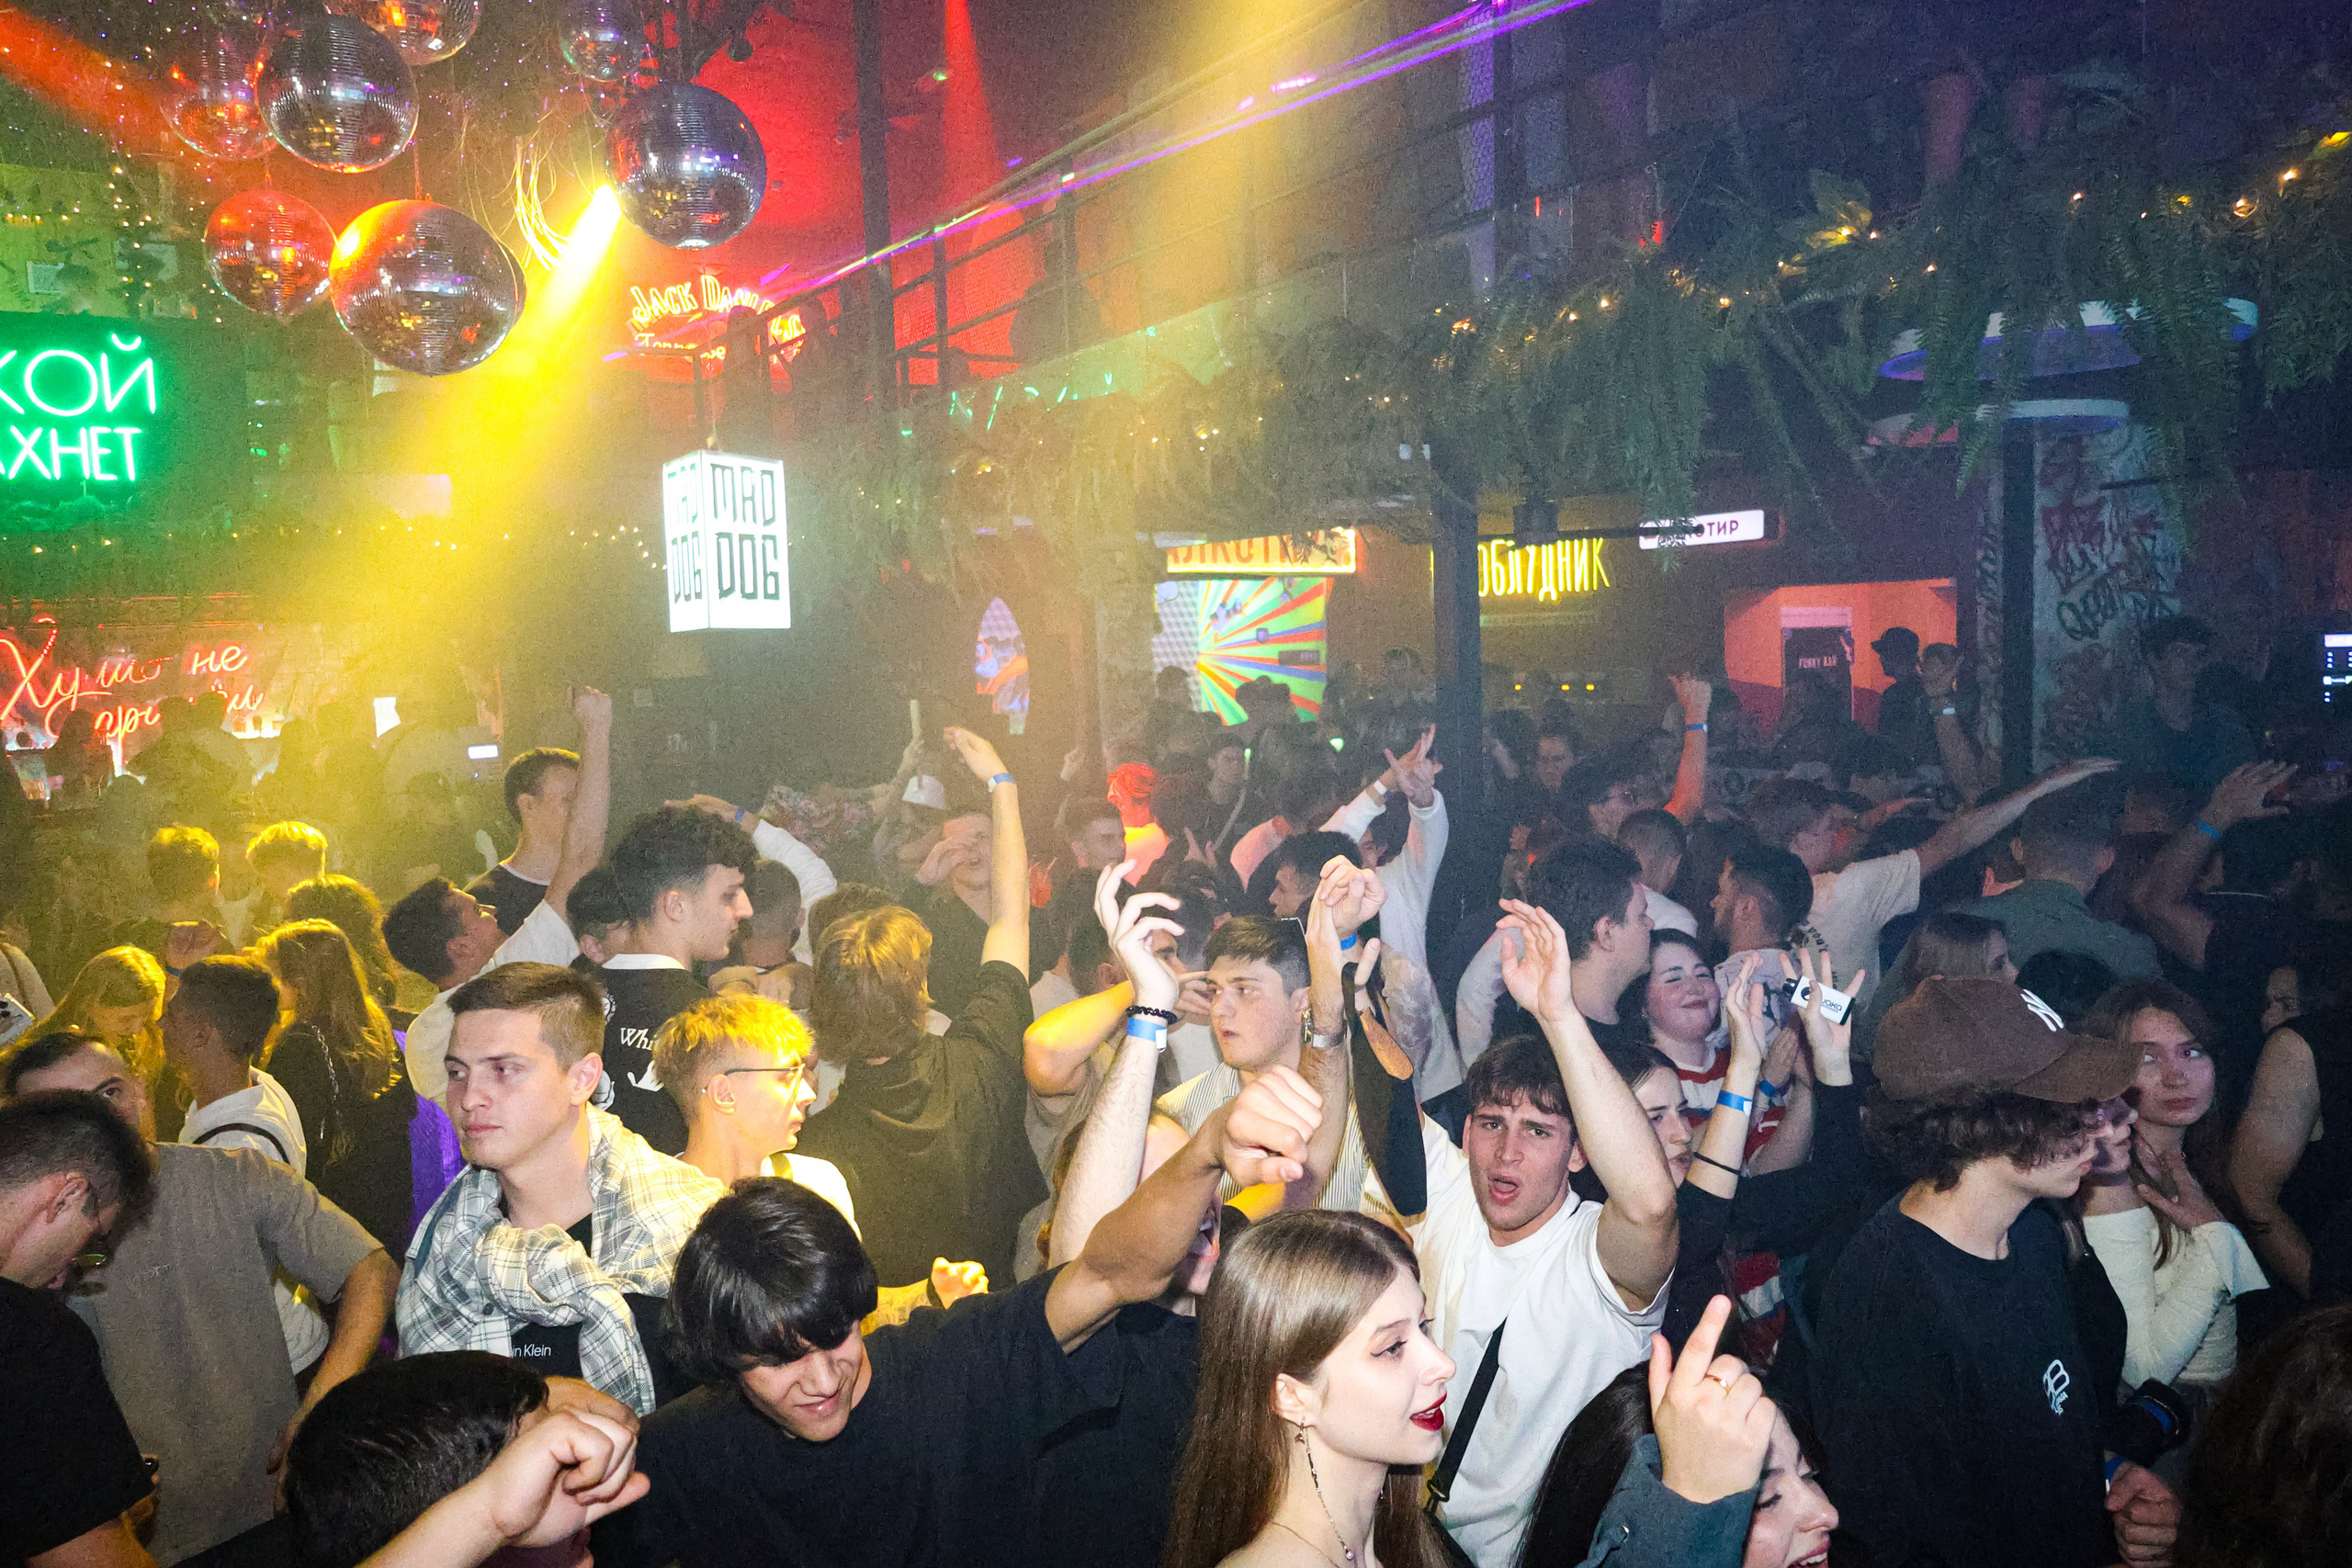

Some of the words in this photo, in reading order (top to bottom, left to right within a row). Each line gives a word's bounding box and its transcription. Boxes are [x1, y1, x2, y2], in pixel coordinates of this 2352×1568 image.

[0, 425, 141, 481] ХНЕТ
[710, 463, 776, 527] MAD
[715, 531, 780, 600] DOG
[1476, 537, 1611, 602] ОБЛУДНИК
[191, 645, 248, 676] не
[620, 1027, 658, 1052] Whi
[524, 1343, 551, 1358] Klein
